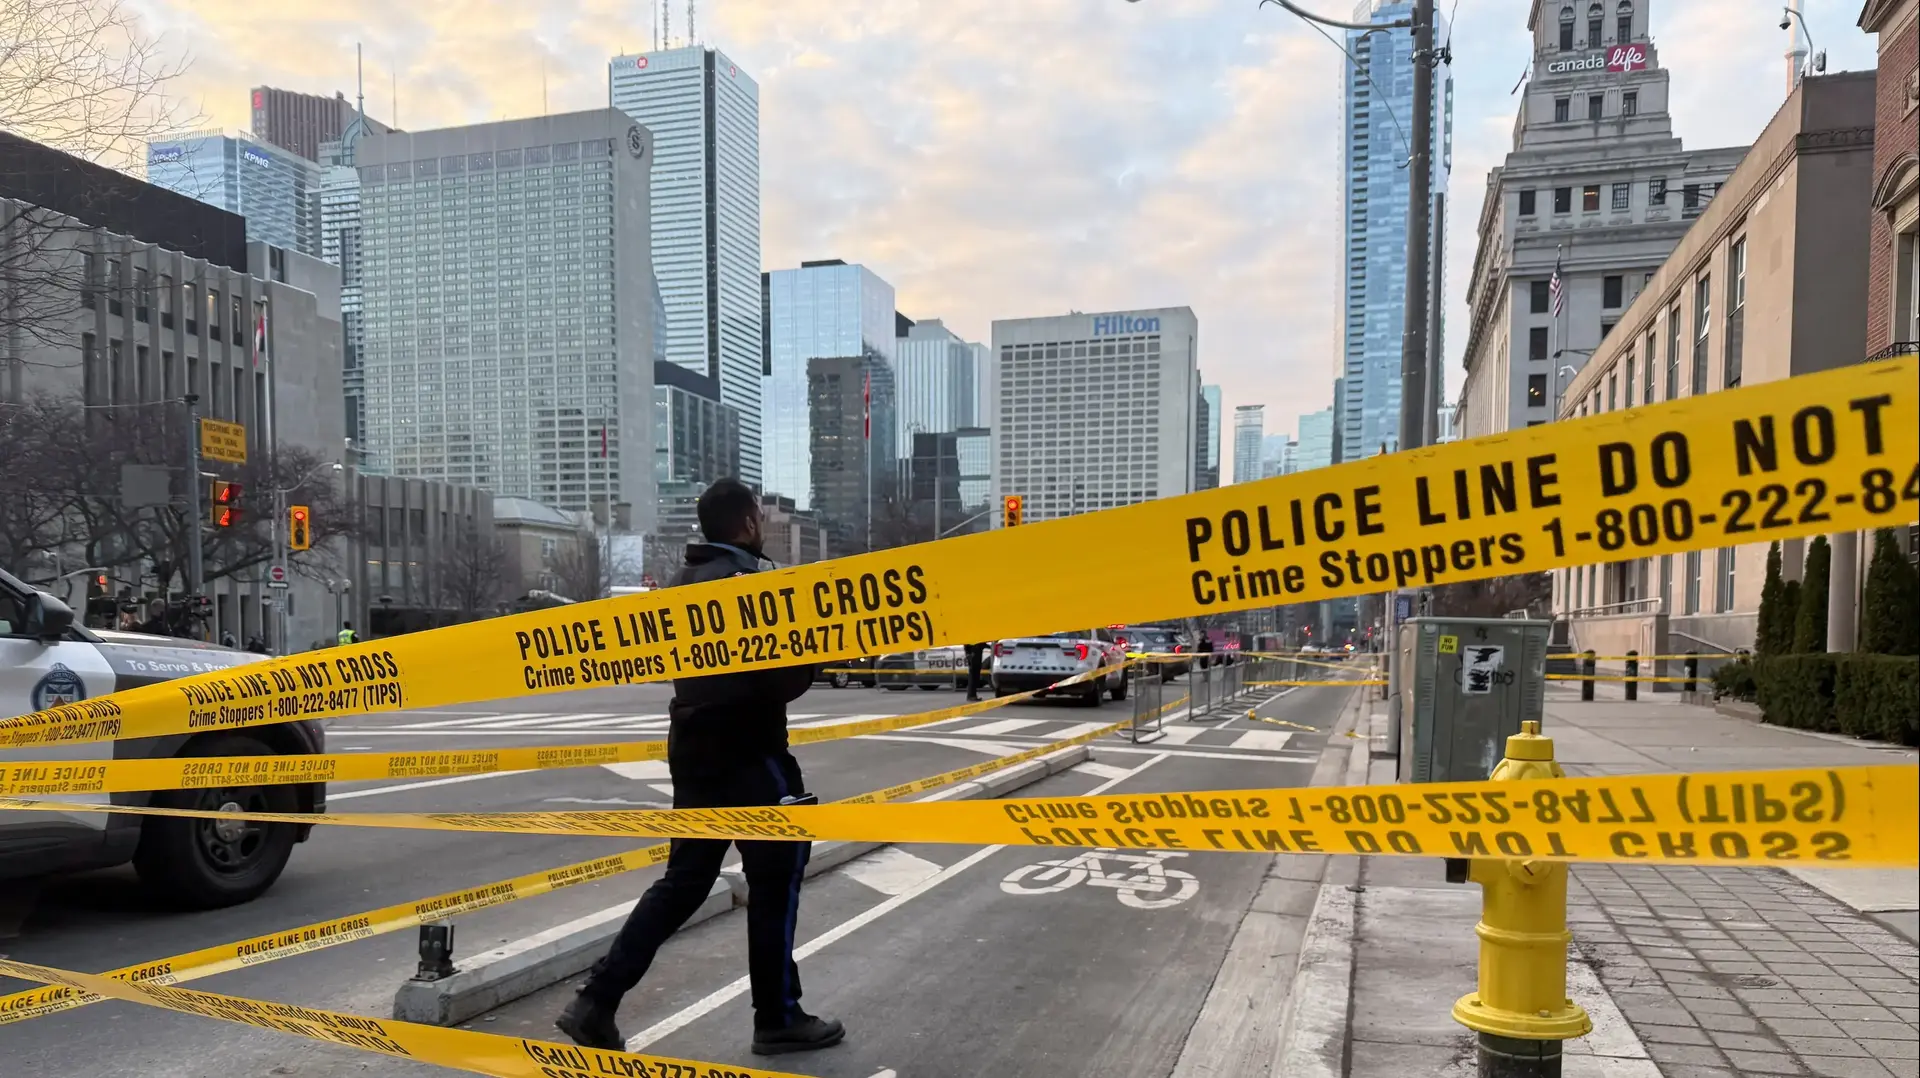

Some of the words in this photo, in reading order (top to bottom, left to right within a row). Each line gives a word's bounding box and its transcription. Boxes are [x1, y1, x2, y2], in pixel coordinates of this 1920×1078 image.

[1548, 55, 1604, 72] canada
[1607, 47, 1646, 72] life
[243, 151, 269, 168] KPMG
[1093, 315, 1160, 336] Hilton
[1186, 485, 1385, 562] POLICE
[1416, 453, 1561, 526] LINE
[1598, 431, 1690, 497] DO
[1733, 394, 1892, 476] NOT
[1191, 565, 1305, 605] Crime
[1319, 532, 1525, 587] Stoppers
[515, 619, 606, 660] POLICE
[614, 608, 677, 647] LINE
[686, 599, 725, 637] DO
[737, 587, 796, 629] NOT
[813, 565, 927, 618] CROSS
[524, 663, 576, 689] Crime
[579, 654, 665, 685] Stoppers
[669, 624, 844, 671] 1-800-222-8477
[856, 611, 934, 654] (TIPS)
[928, 658, 970, 668] POLCE
[126, 660, 146, 671] To
[148, 660, 189, 672] Serve
[191, 662, 204, 672] &
[179, 679, 235, 706] POLICE
[231, 669, 271, 699] LINE
[270, 668, 298, 693] DO
[295, 662, 333, 689] NOT
[335, 651, 399, 684] CROSS
[20, 713, 46, 726] LINE
[60, 706, 83, 721] NOT
[80, 700, 121, 719] CROSS
[189, 709, 216, 728] Crime
[219, 703, 264, 726] Stoppers
[267, 687, 358, 718] 1-800-222-8477
[363, 682, 402, 711] (TIPS)
[96, 719, 121, 740] (TIPS)
[416, 899, 443, 914] POLICE
[445, 896, 461, 907] LINE
[491, 883, 513, 896] CROSS
[237, 939, 274, 957] POLICE
[278, 933, 300, 948] LINE
[303, 929, 317, 941] DO
[319, 924, 338, 937] NOT
[341, 917, 369, 932] CROSS
[131, 963, 172, 982] CROSS
[1, 994, 34, 1013] LICE
[41, 987, 71, 1003] LINE
[333, 1015, 388, 1037] Crime
[522, 1040, 591, 1071] (TIPS)
